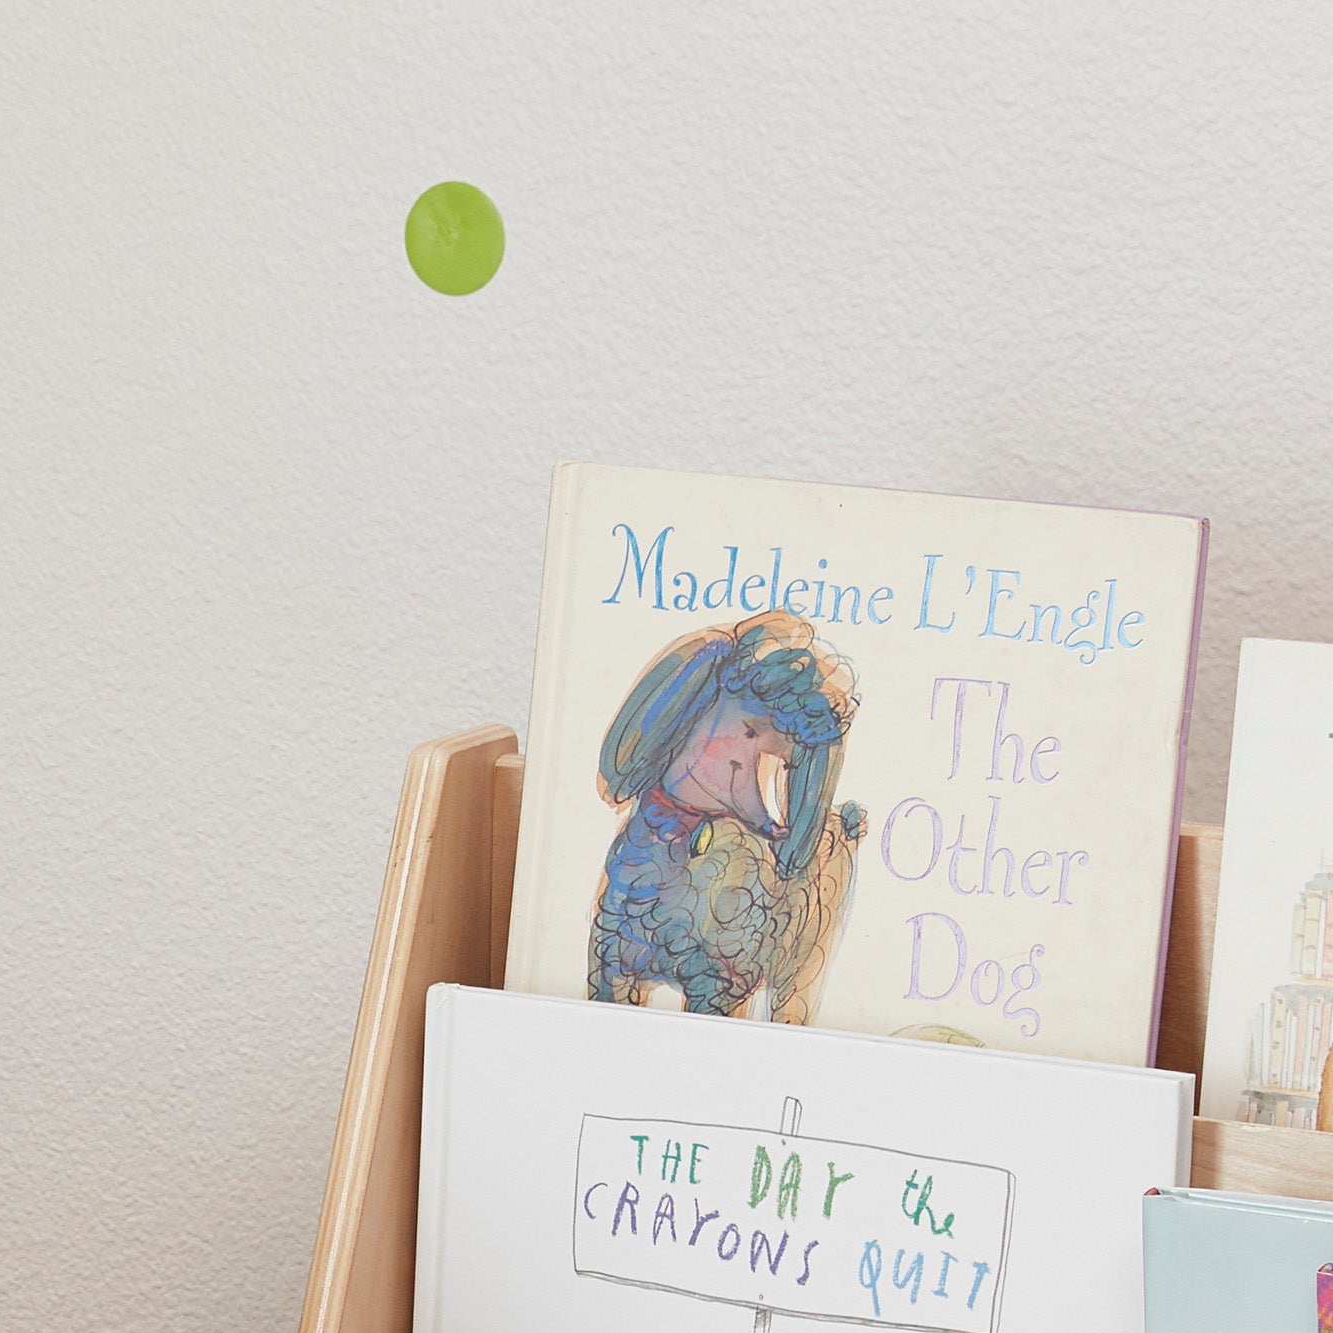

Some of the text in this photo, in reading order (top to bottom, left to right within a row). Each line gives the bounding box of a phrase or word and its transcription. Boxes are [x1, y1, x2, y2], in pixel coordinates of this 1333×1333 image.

[602, 523, 1146, 664] Madeleine L'Engle
[931, 677, 1062, 785] The
[880, 795, 1090, 906] Other
[903, 912, 1045, 1037] Dog
[630, 1135, 955, 1240] THE DAY the
[583, 1181, 993, 1317] CRAYONS QUIT
